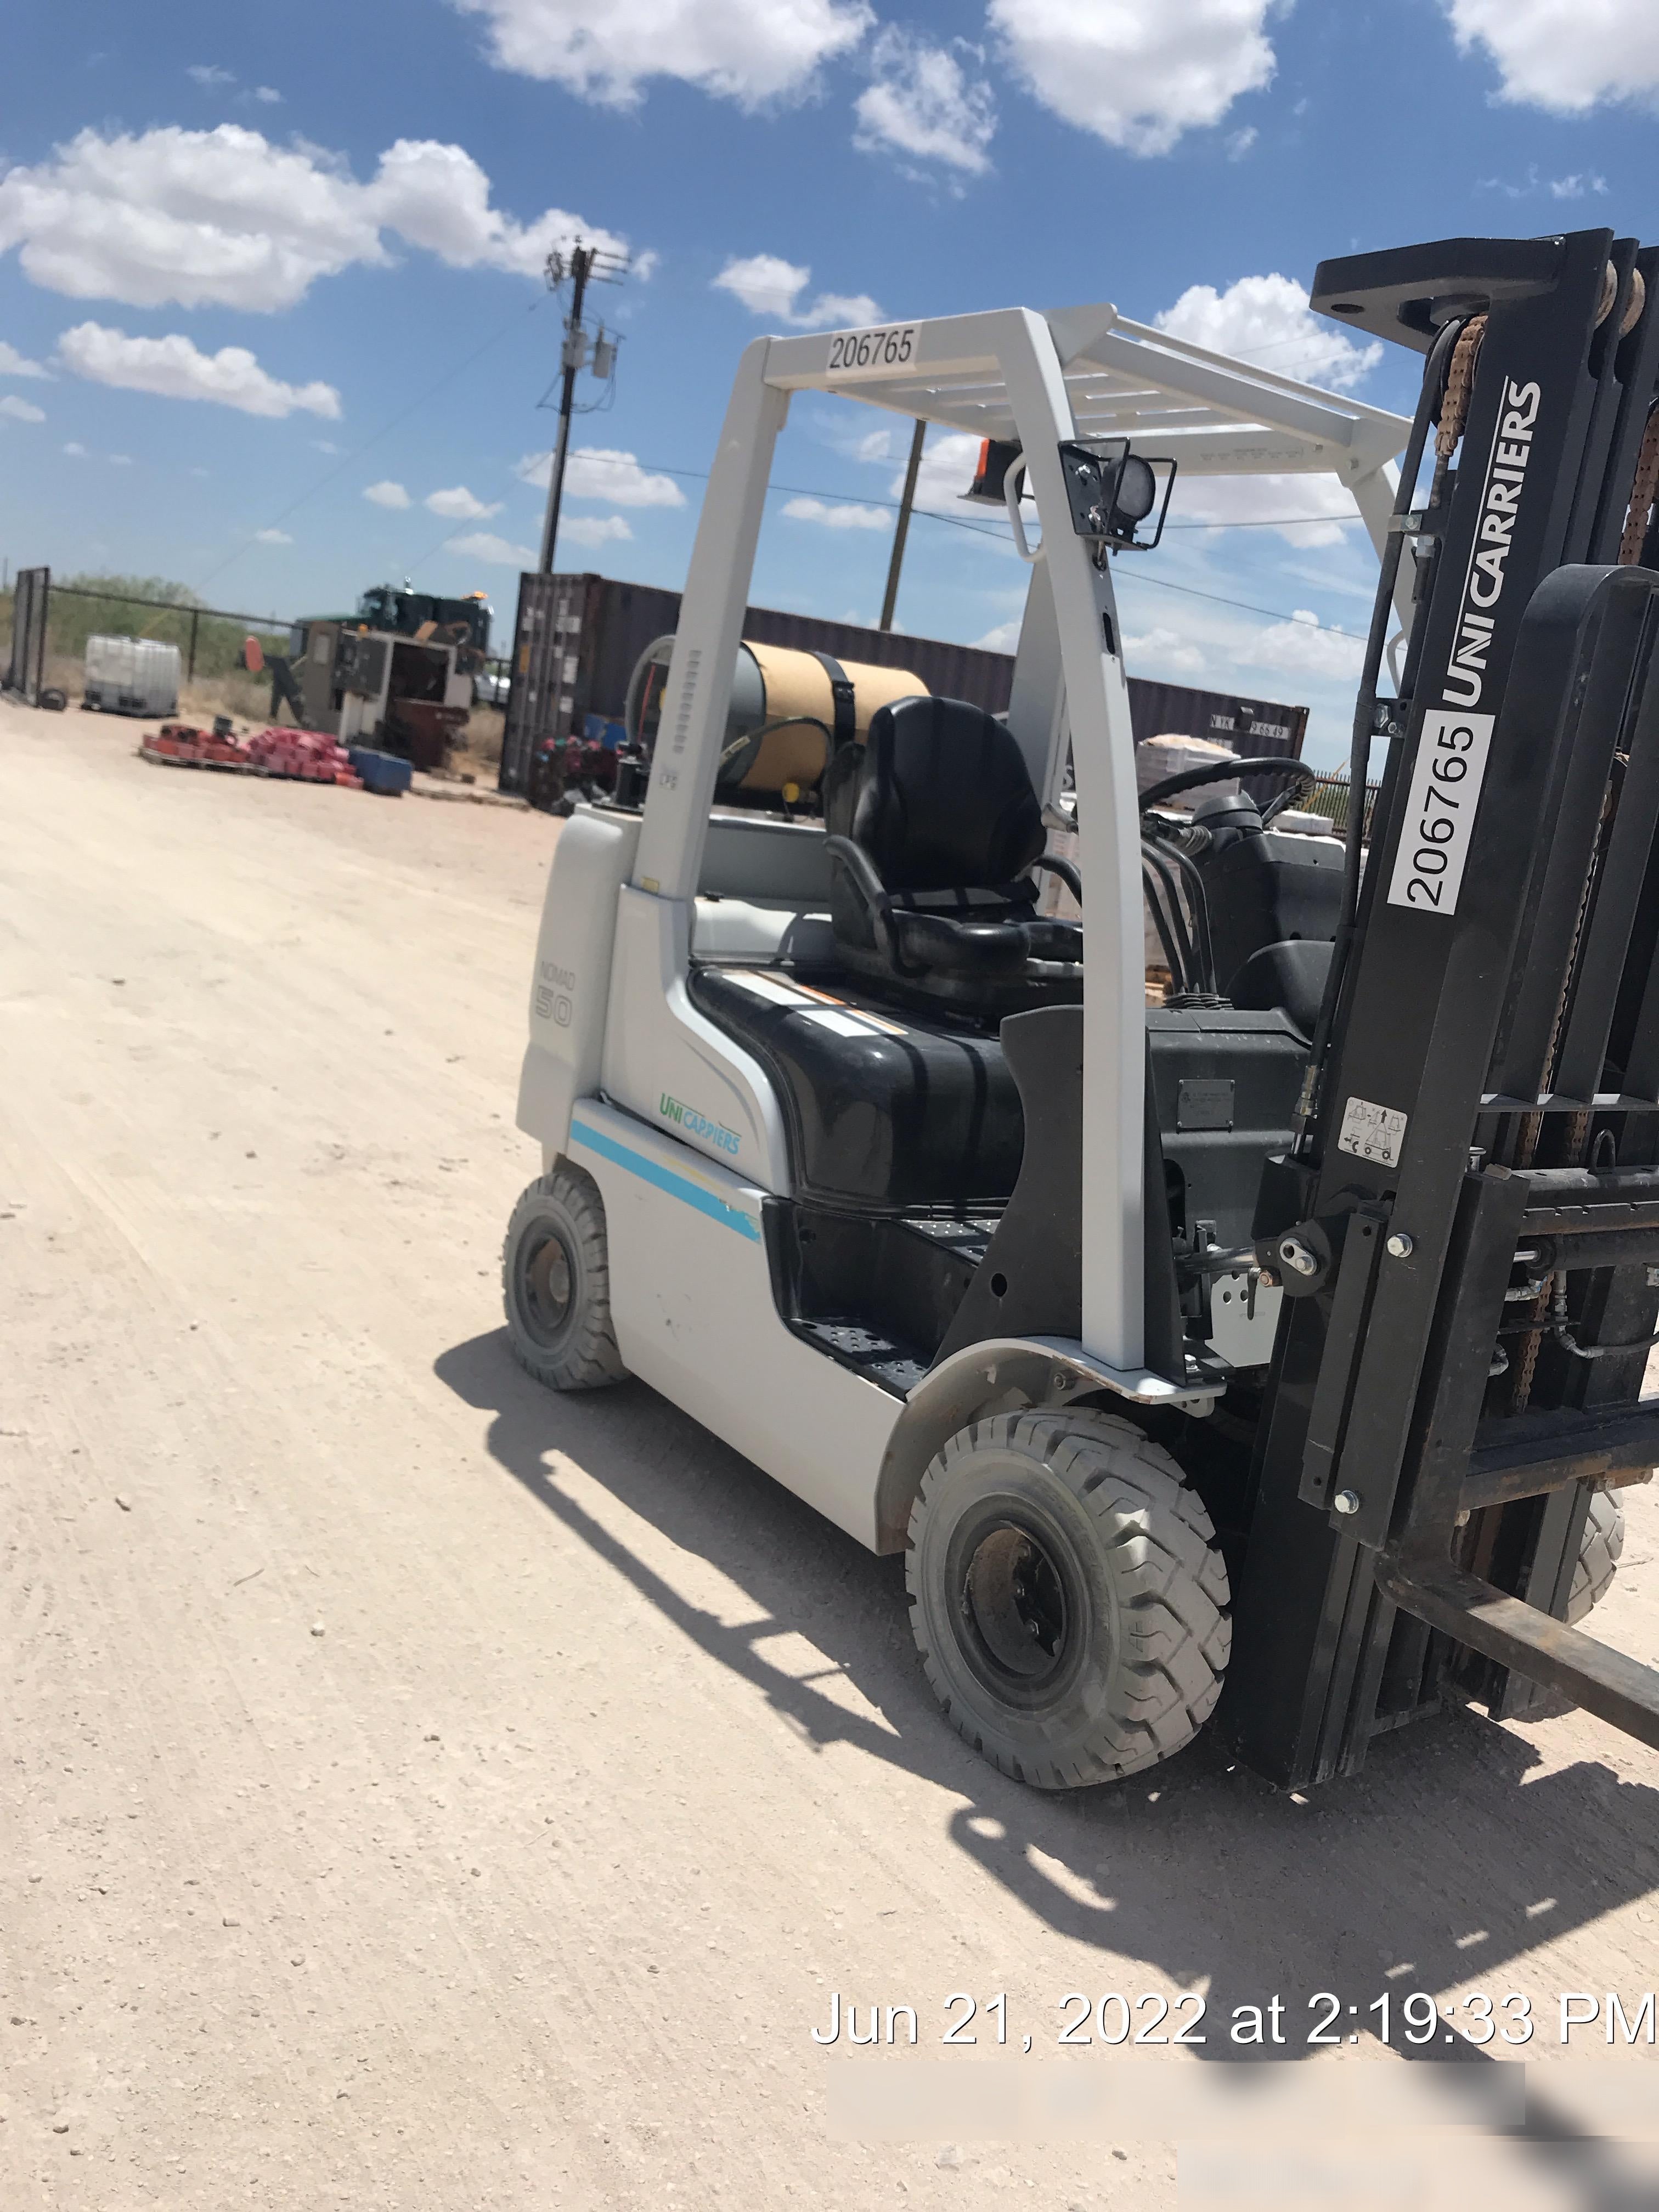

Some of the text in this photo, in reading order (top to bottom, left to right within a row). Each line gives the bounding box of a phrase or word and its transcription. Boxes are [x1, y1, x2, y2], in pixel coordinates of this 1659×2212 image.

[829, 329, 915, 369] 206765
[1407, 726, 1474, 906] 206765
[535, 985, 572, 1028] 50
